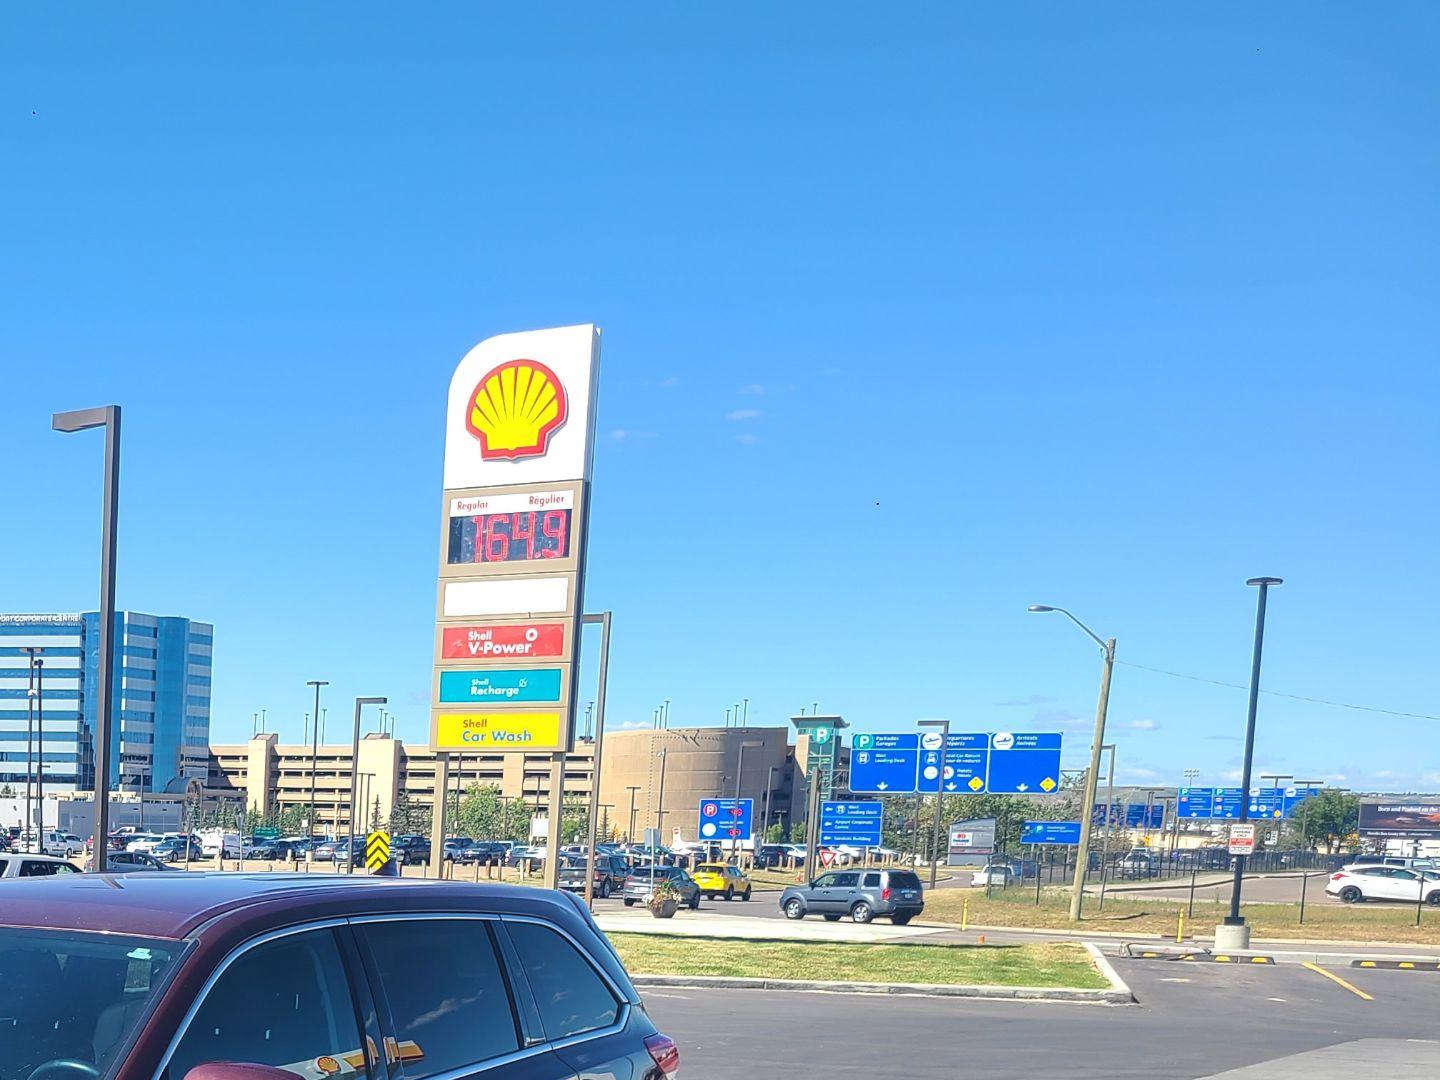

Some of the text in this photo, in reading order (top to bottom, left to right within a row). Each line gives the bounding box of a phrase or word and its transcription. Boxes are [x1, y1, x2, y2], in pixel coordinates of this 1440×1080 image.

[456, 499, 489, 512] Regular
[472, 509, 567, 564] 164.9
[467, 629, 492, 641] Shell
[467, 641, 532, 655] V-Power
[471, 678, 489, 686] Shell
[470, 685, 519, 697] Recharge
[462, 718, 488, 729] Shell
[462, 728, 533, 743] Car Wash
[859, 735, 869, 748] P
